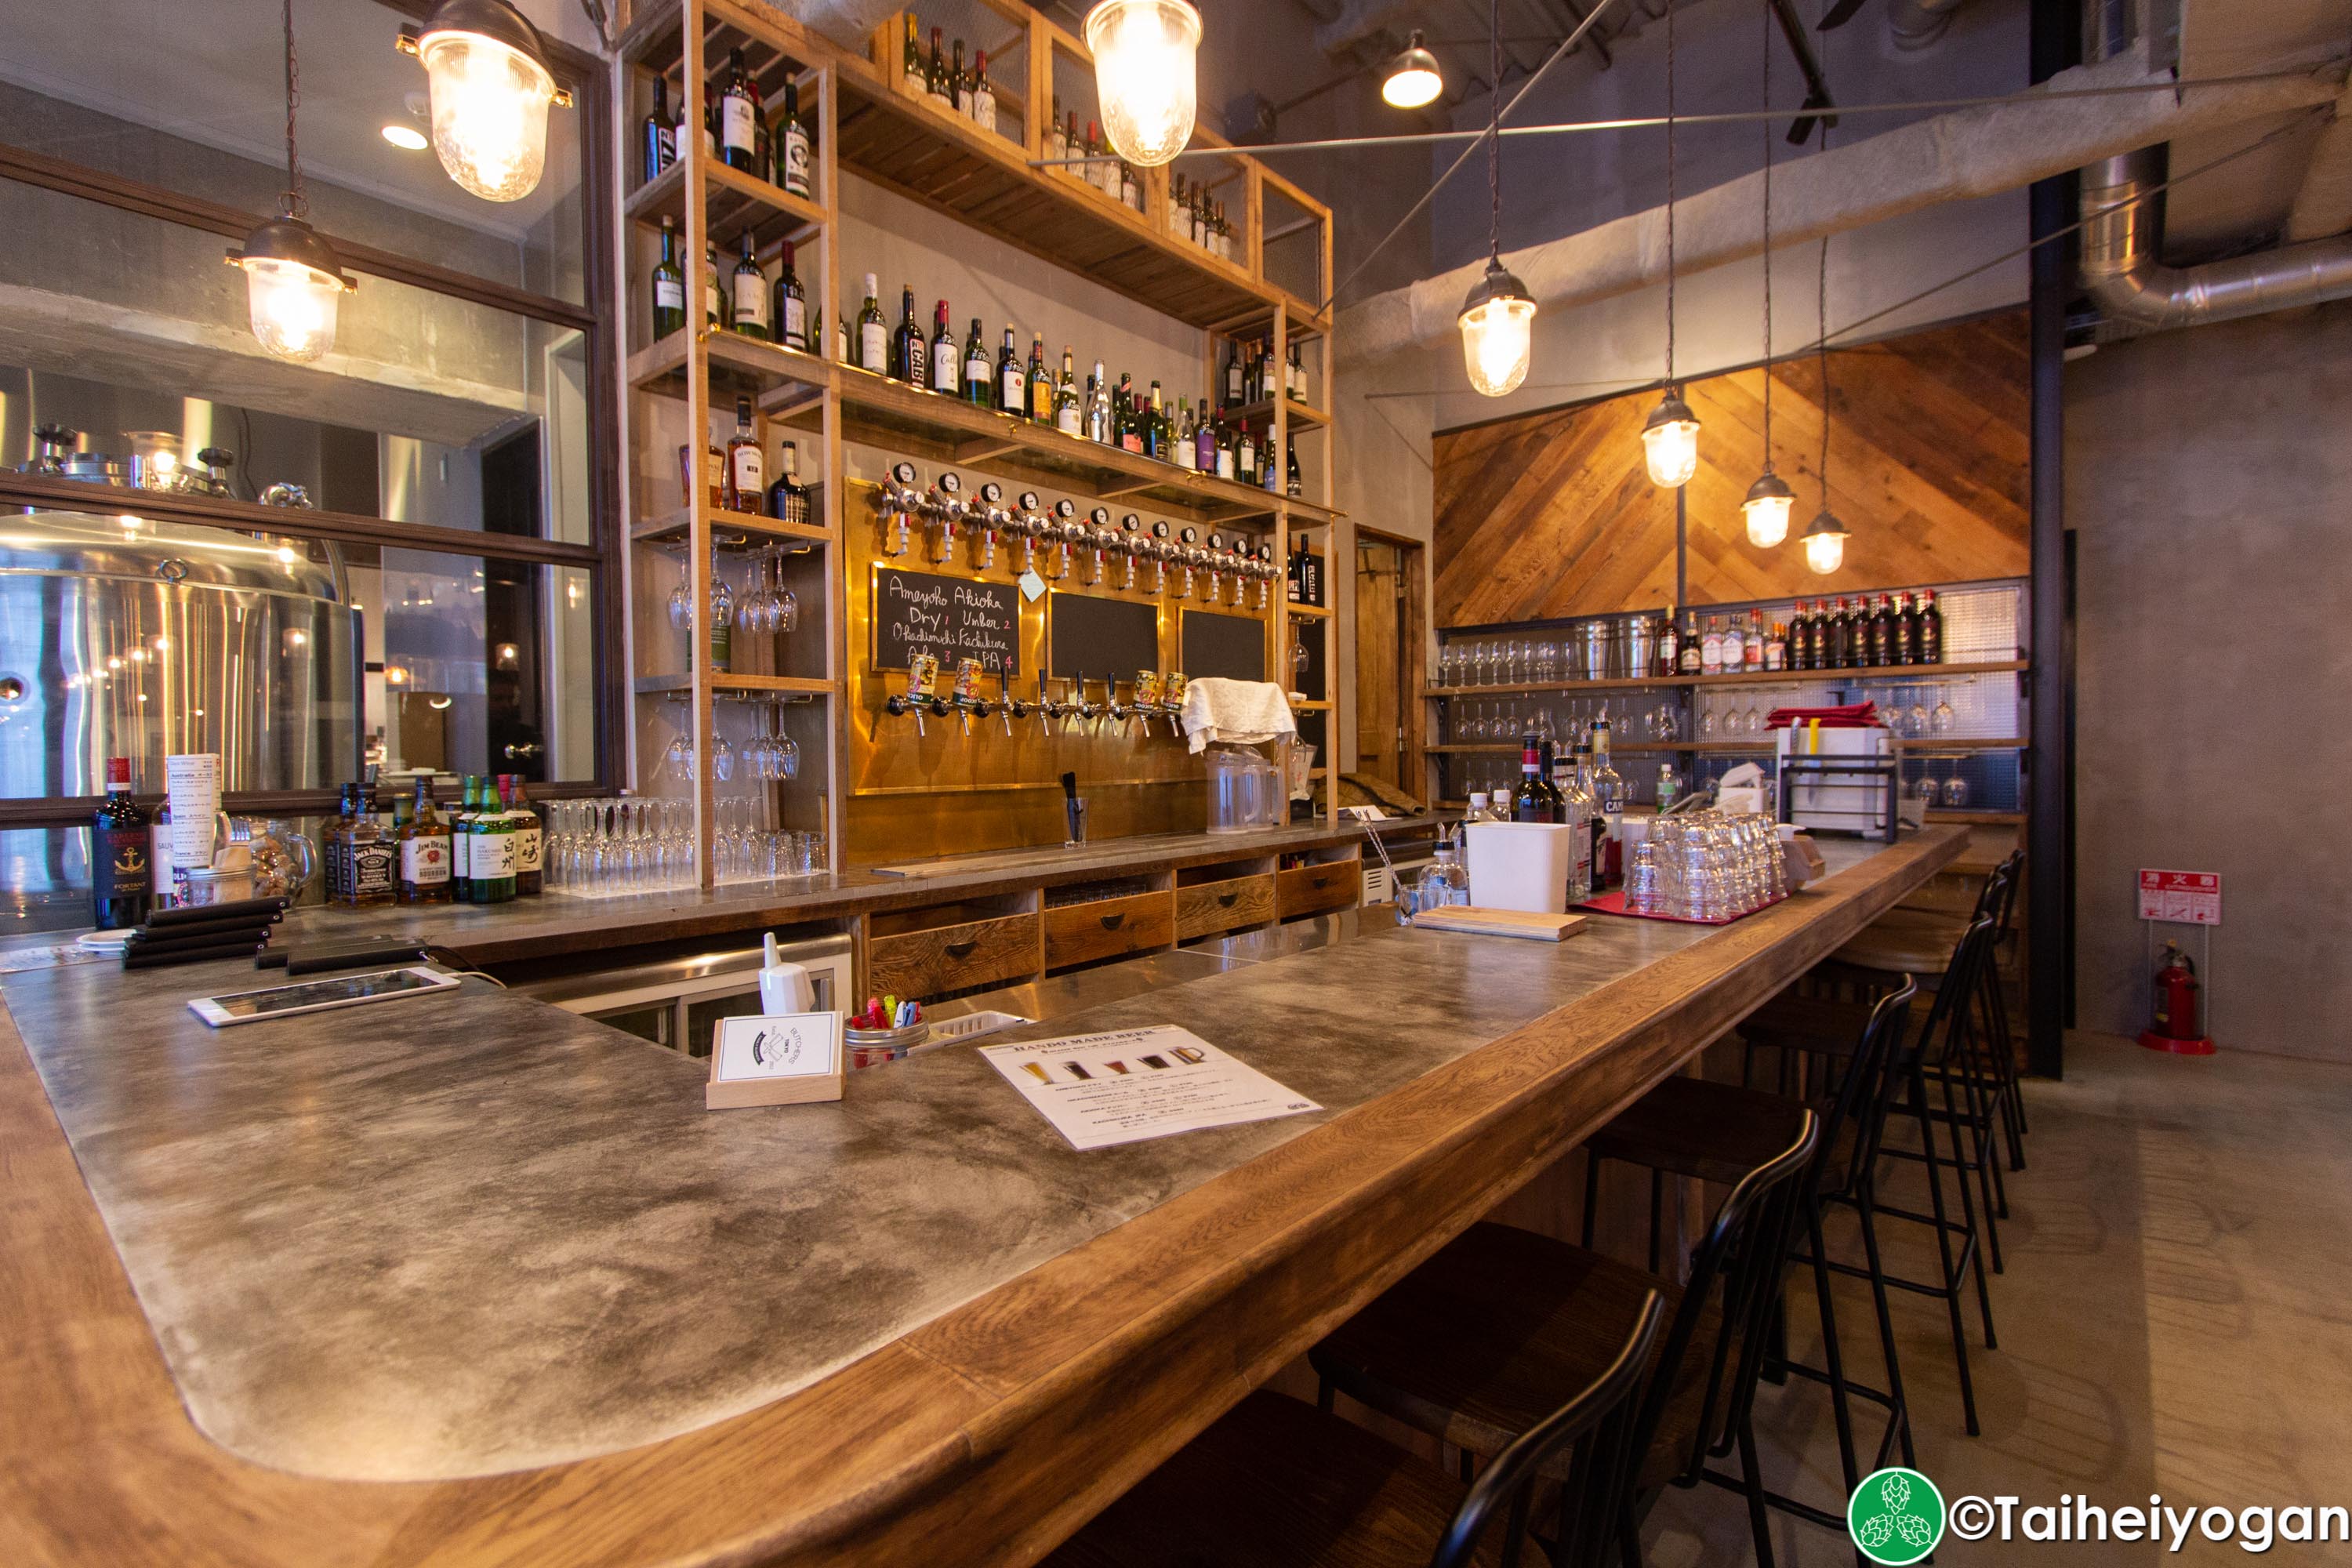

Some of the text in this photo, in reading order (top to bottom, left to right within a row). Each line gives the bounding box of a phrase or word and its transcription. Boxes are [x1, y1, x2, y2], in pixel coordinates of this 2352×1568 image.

[913, 350, 923, 379] CAB
[889, 575, 947, 609] Ameyoko
[909, 607, 941, 631] Dry
[944, 615, 949, 625] 1
[1004, 619, 1011, 629] 2
[943, 650, 951, 662] 3
[972, 651, 1001, 670] IPA
[1005, 655, 1013, 669] 4
[354, 849, 369, 861] JACK
[416, 840, 448, 854] JIM BEAM
[502, 837, 514, 871] 白州
[789, 1027, 802, 1065] BUTCHERS
[1069, 1034, 1114, 1046] MADE
[1116, 1029, 1156, 1039] BEER
